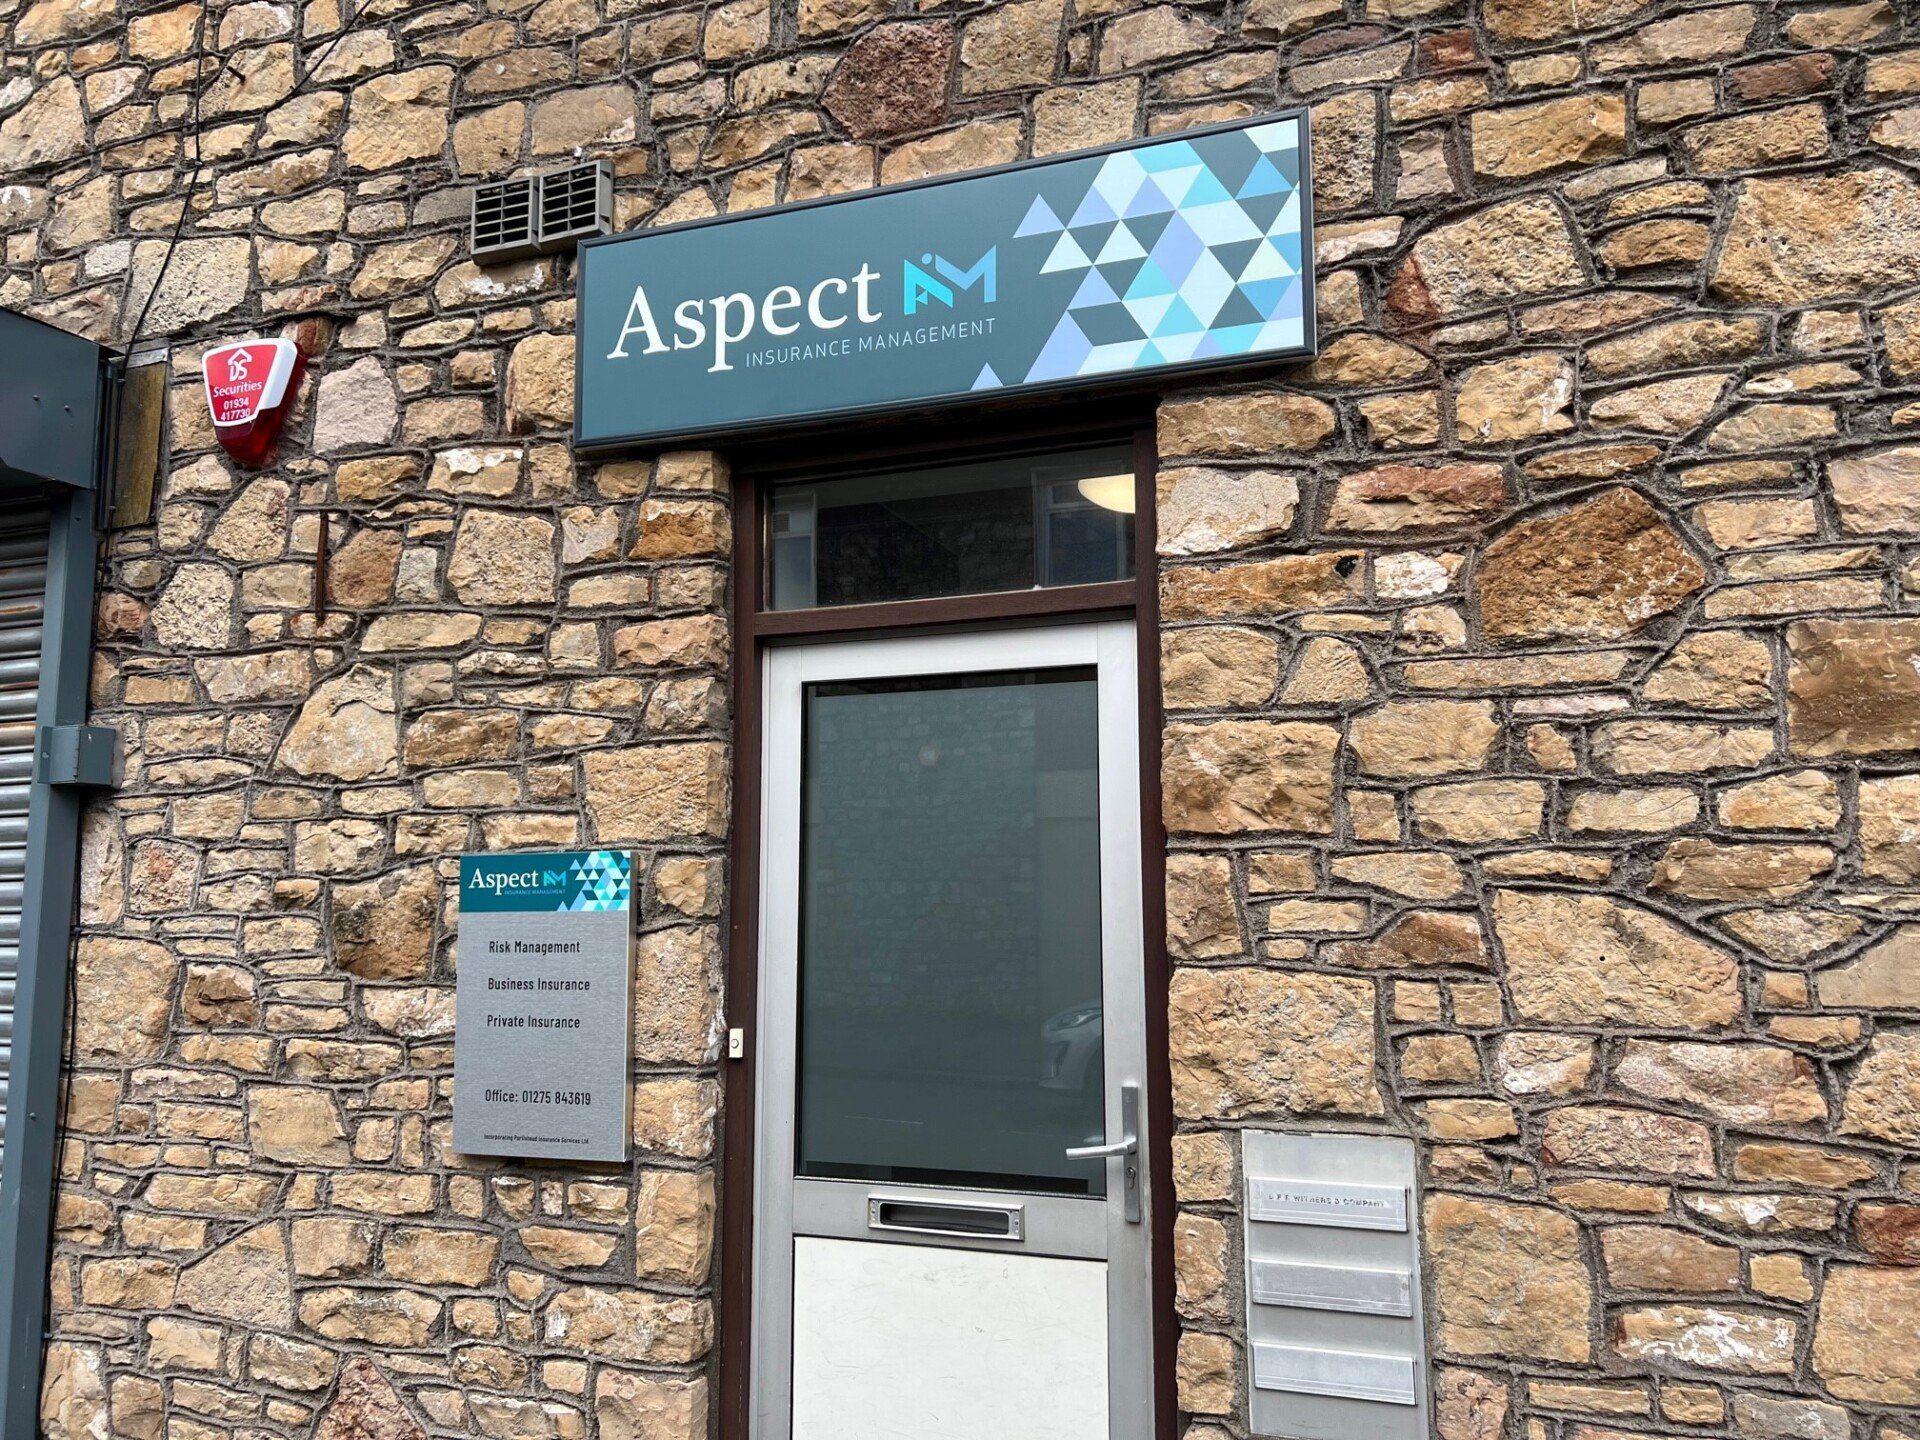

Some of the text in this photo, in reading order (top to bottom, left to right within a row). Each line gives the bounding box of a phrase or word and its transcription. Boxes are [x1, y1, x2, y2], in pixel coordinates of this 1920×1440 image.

[606, 262, 883, 373] Aspect
[745, 317, 996, 368] INSURANCE MANAGEMENT
[213, 381, 263, 398] Securities
[223, 397, 250, 411] 01934
[220, 408, 251, 421] 417730
[468, 867, 539, 896] Aspect
[489, 941, 581, 956] Risk Management
[488, 977, 591, 991] Business Insurance
[487, 1014, 580, 1029] Private Insurance
[485, 1089, 591, 1105] Office: 01275 843619
